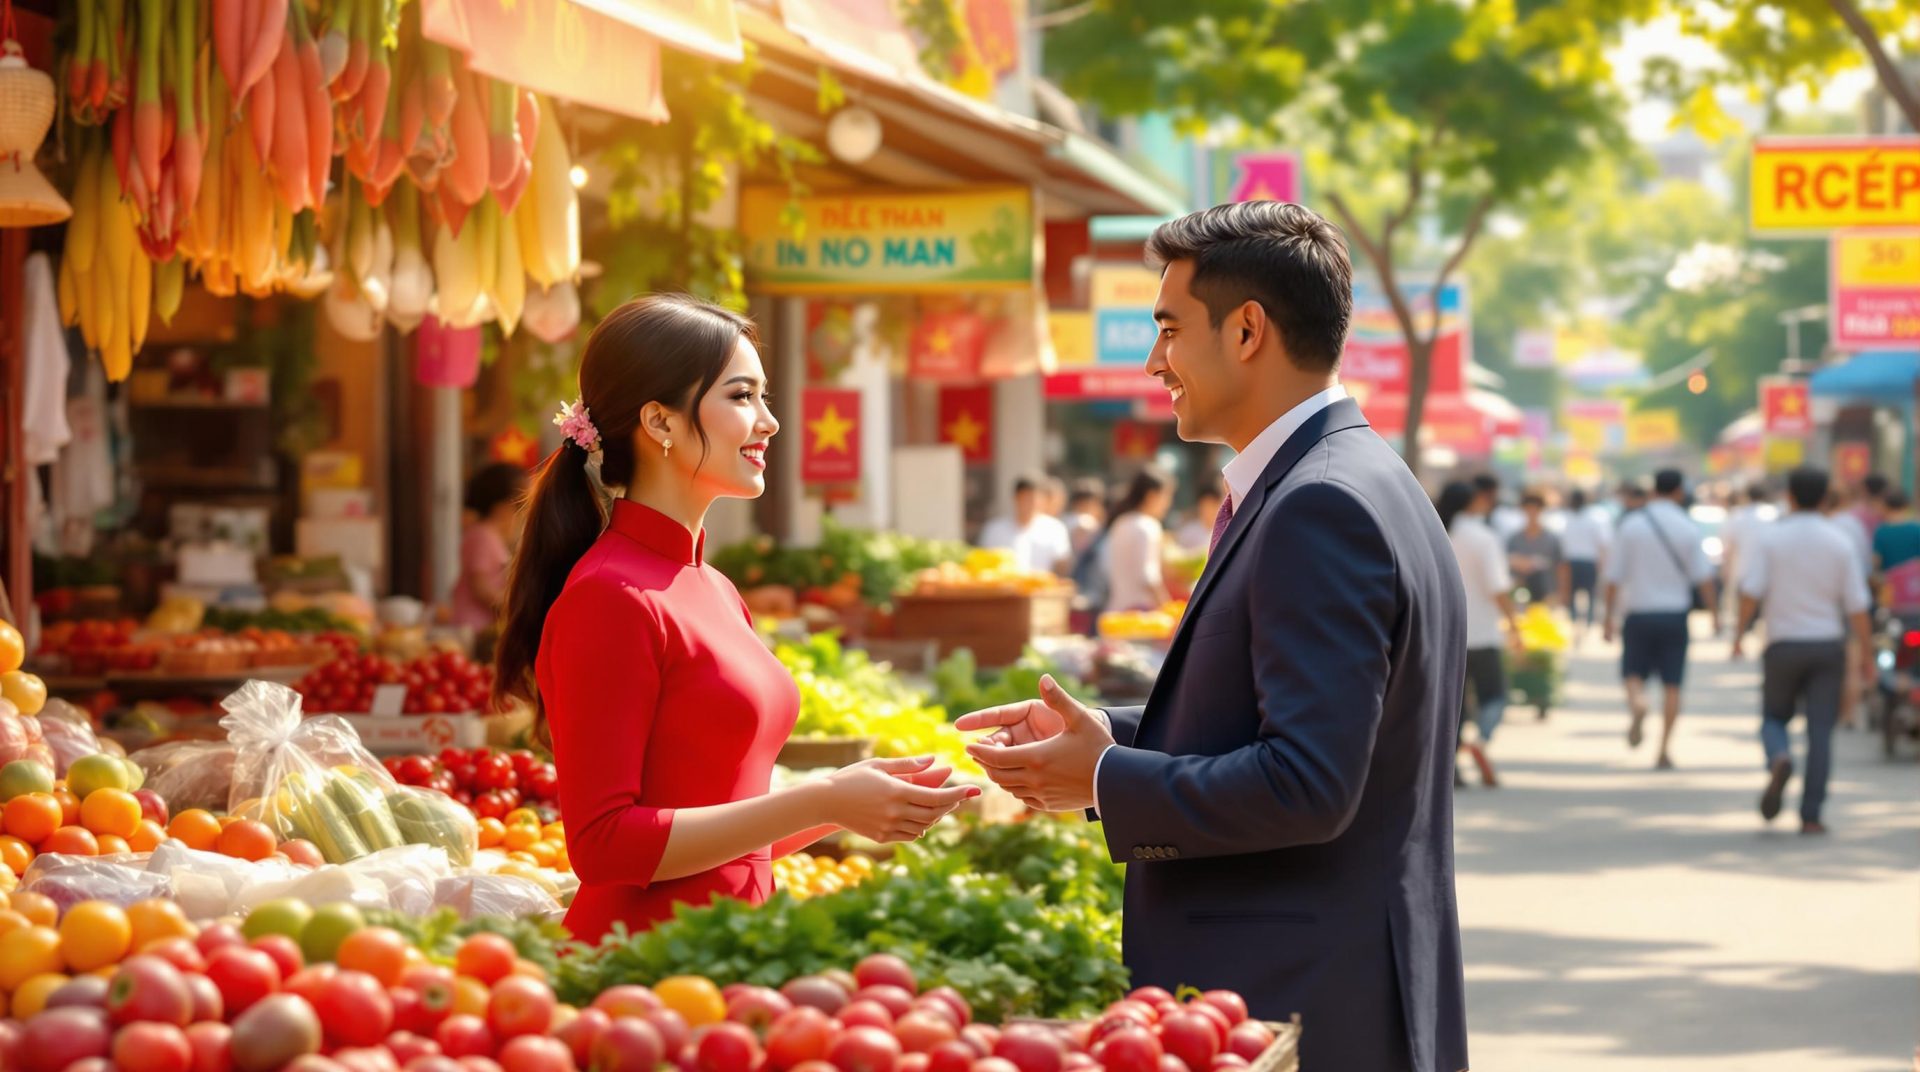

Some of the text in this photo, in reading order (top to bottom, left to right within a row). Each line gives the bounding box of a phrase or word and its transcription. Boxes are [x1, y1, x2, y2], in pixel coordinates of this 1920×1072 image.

[777, 238, 807, 266] IN
[820, 237, 870, 267] NO
[883, 238, 955, 267] MAN
